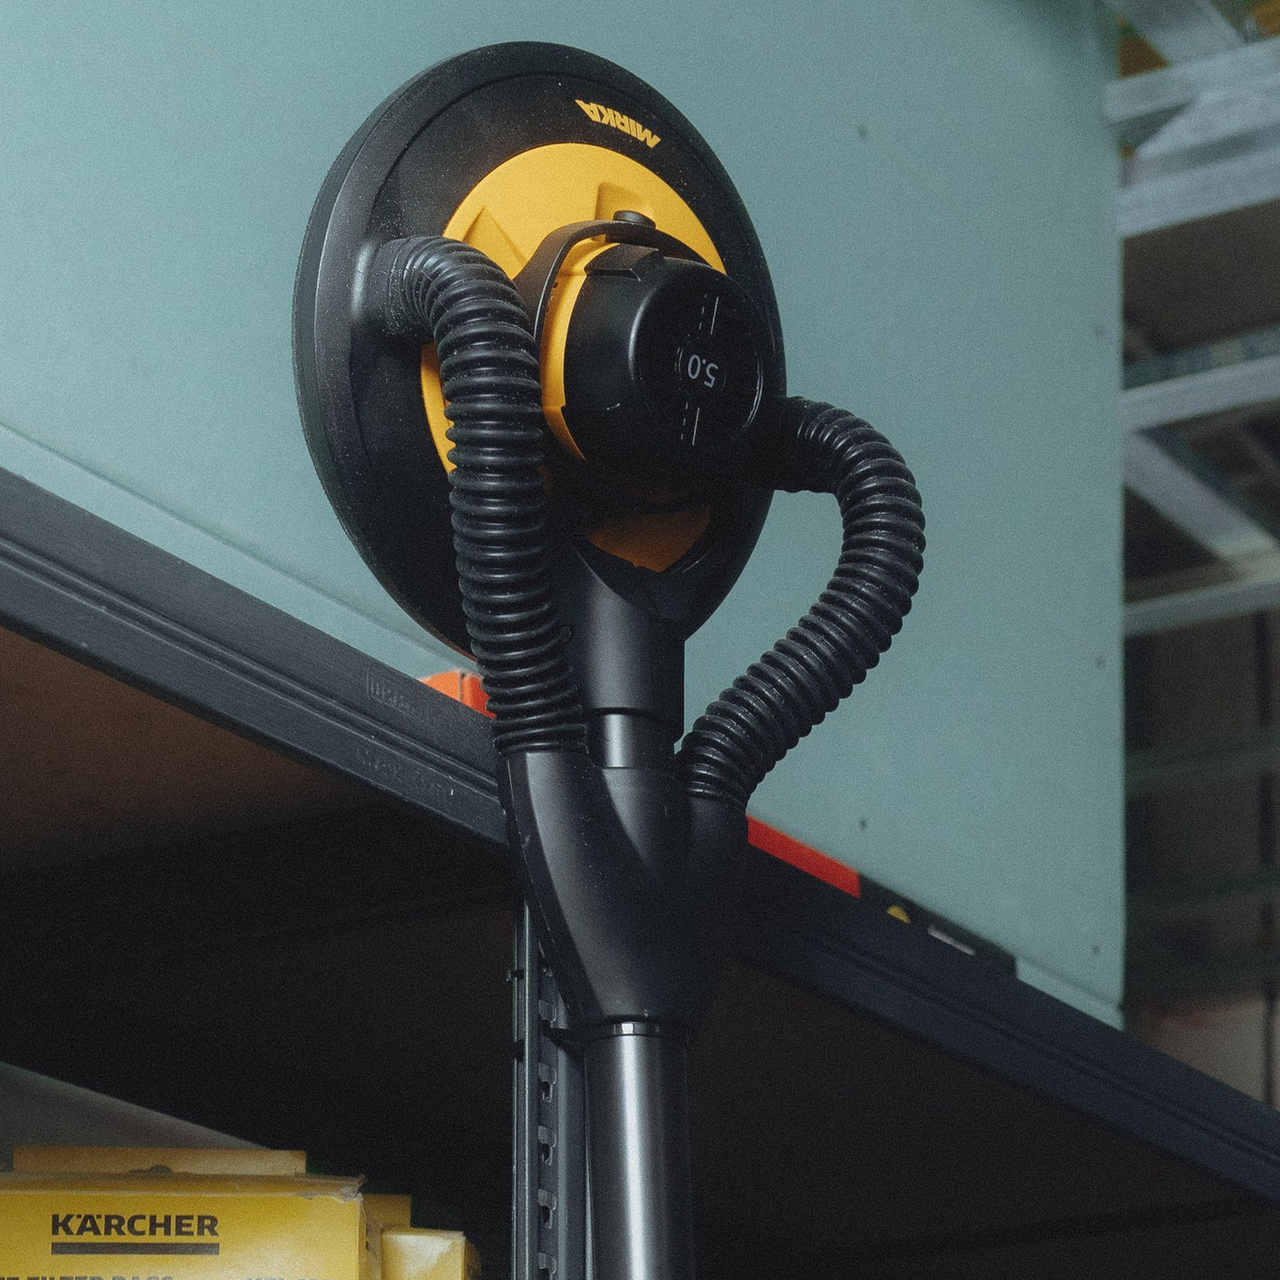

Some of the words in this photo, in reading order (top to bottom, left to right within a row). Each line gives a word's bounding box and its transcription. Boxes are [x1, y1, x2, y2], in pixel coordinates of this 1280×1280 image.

[575, 99, 661, 149] MIRKA
[688, 354, 719, 388] 5.0
[51, 1214, 219, 1236] KÄRCHER
